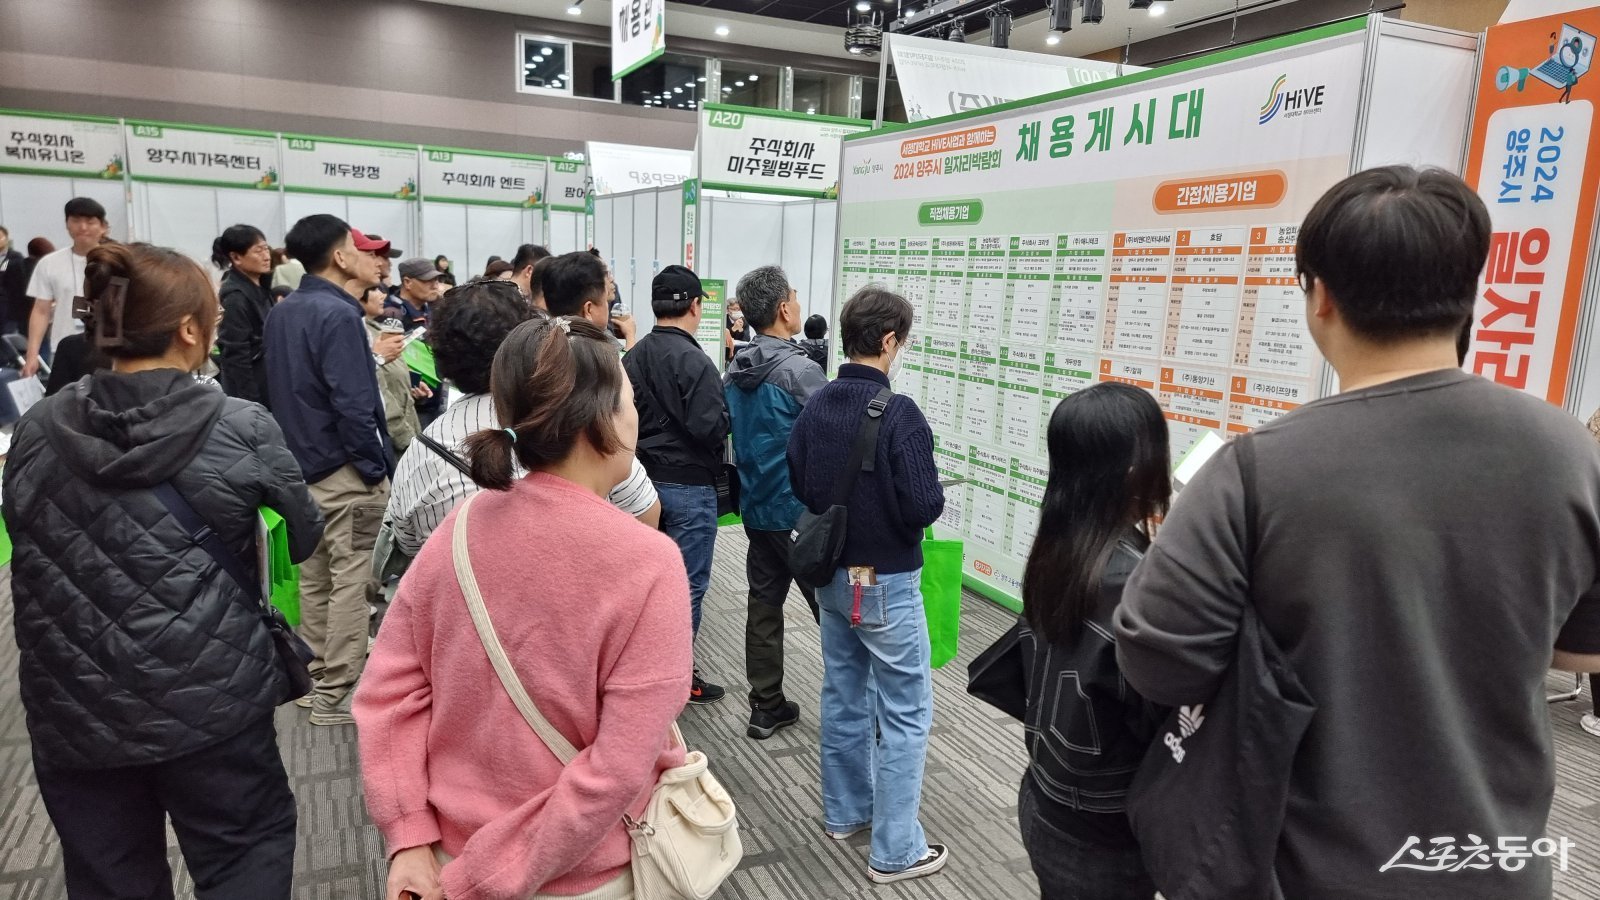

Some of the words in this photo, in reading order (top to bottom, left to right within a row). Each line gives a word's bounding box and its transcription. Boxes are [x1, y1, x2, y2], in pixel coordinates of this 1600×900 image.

[1285, 85, 1325, 111] HiVE
[711, 111, 741, 126] A20
[10, 131, 75, 148] 주식회사
[136, 125, 160, 137] A15
[291, 139, 312, 150] A14
[749, 137, 815, 159] 주식회사
[901, 141, 931, 156] 서정대학교
[931, 135, 966, 151] HiVE사업과
[966, 130, 995, 146] 함께하는
[5, 145, 86, 165] 복지유니온
[147, 147, 262, 171] 양주시가족센터
[431, 151, 451, 162] A13
[557, 163, 576, 172] A12
[727, 155, 826, 180] 미주웰빙푸드
[893, 163, 915, 180] 2024
[916, 157, 943, 178] 양주시
[944, 149, 1003, 174] 일자리박람회
[1497, 128, 1531, 204] 양주시
[1530, 126, 1564, 203] 2024
[442, 172, 496, 188] 주식회사
[499, 174, 526, 191] 엔트
[1176, 180, 1257, 206] 간접채용기업
[929, 205, 970, 221] 직접채용기업
[1181, 234, 1186, 242] 2
[1256, 232, 1261, 240] 3
[1164, 371, 1169, 379] 5
[1236, 380, 1241, 389] 6
